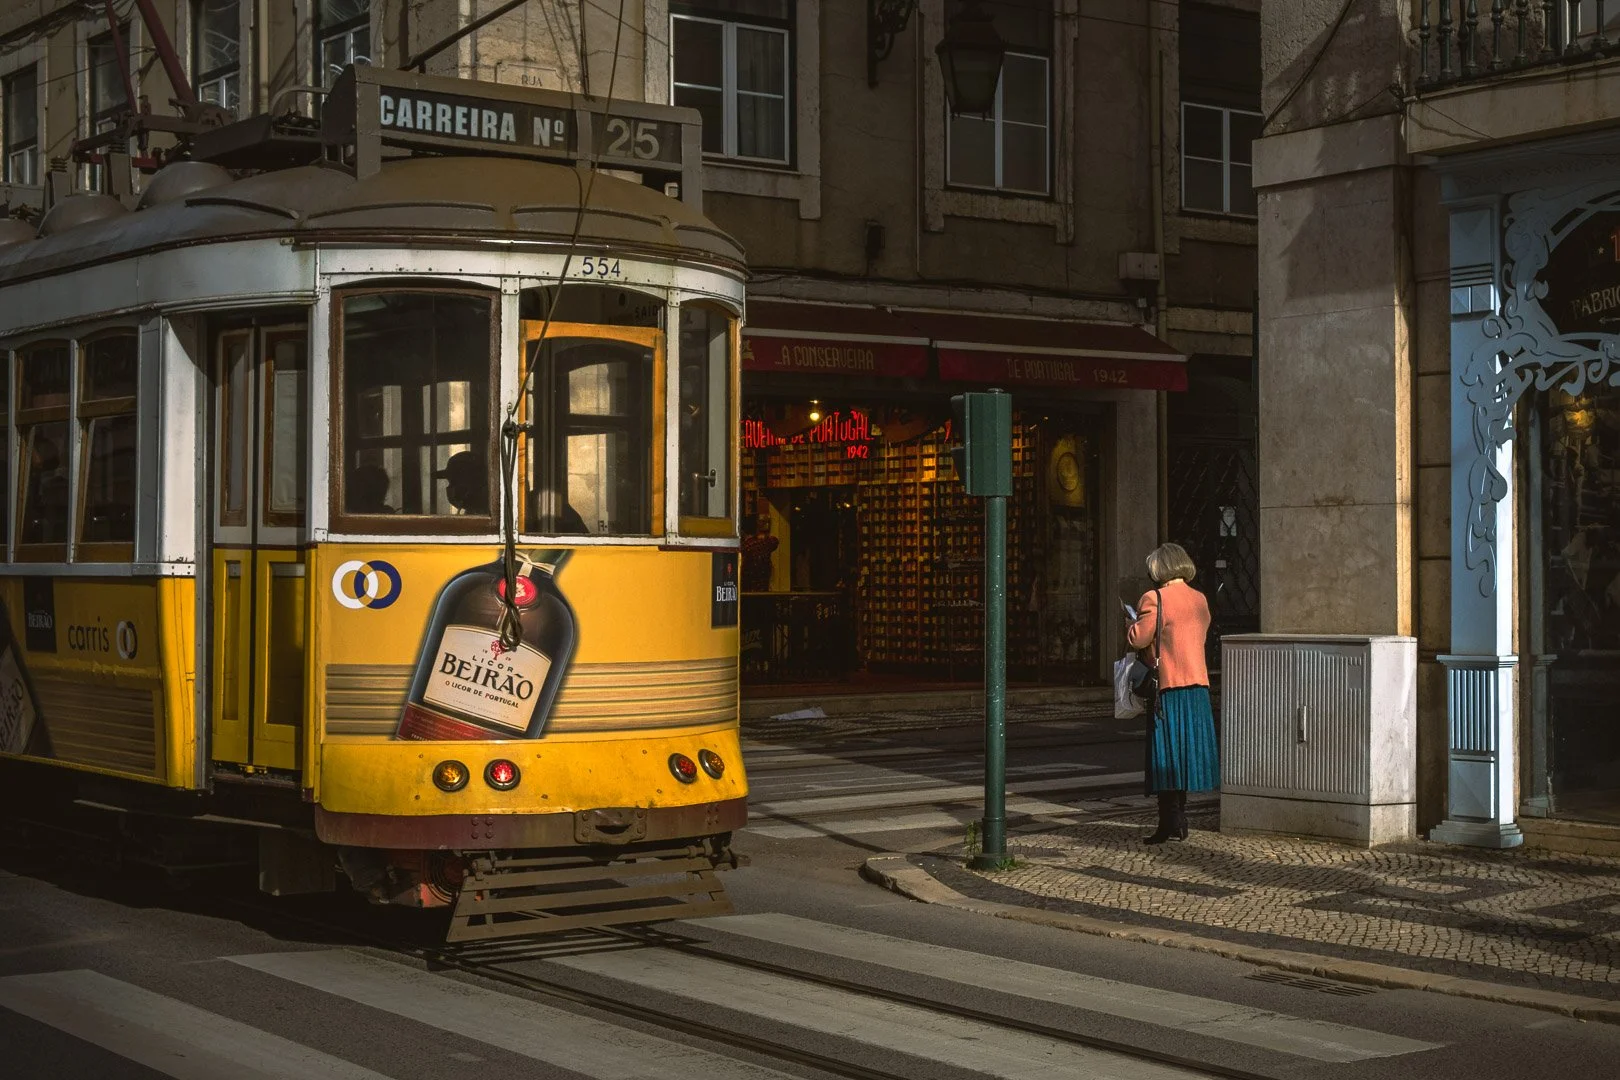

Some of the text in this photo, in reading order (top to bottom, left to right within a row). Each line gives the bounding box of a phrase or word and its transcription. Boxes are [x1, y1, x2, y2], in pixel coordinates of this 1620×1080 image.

[521, 74, 543, 87] RUA
[380, 94, 516, 142] CARREIRA
[606, 118, 660, 159] 25
[582, 257, 621, 277] 554
[794, 346, 875, 370] CONSERVEIRA
[1006, 358, 1128, 383] DE PORTUGAL 1942
[847, 445, 868, 459] 1942
[67, 616, 110, 653] carris
[472, 654, 515, 673] LICOR
[439, 652, 534, 701] BEIRÃO
[452, 681, 472, 693] LICOR
[473, 688, 483, 696] DE
[484, 692, 520, 709] PORTUGAL
